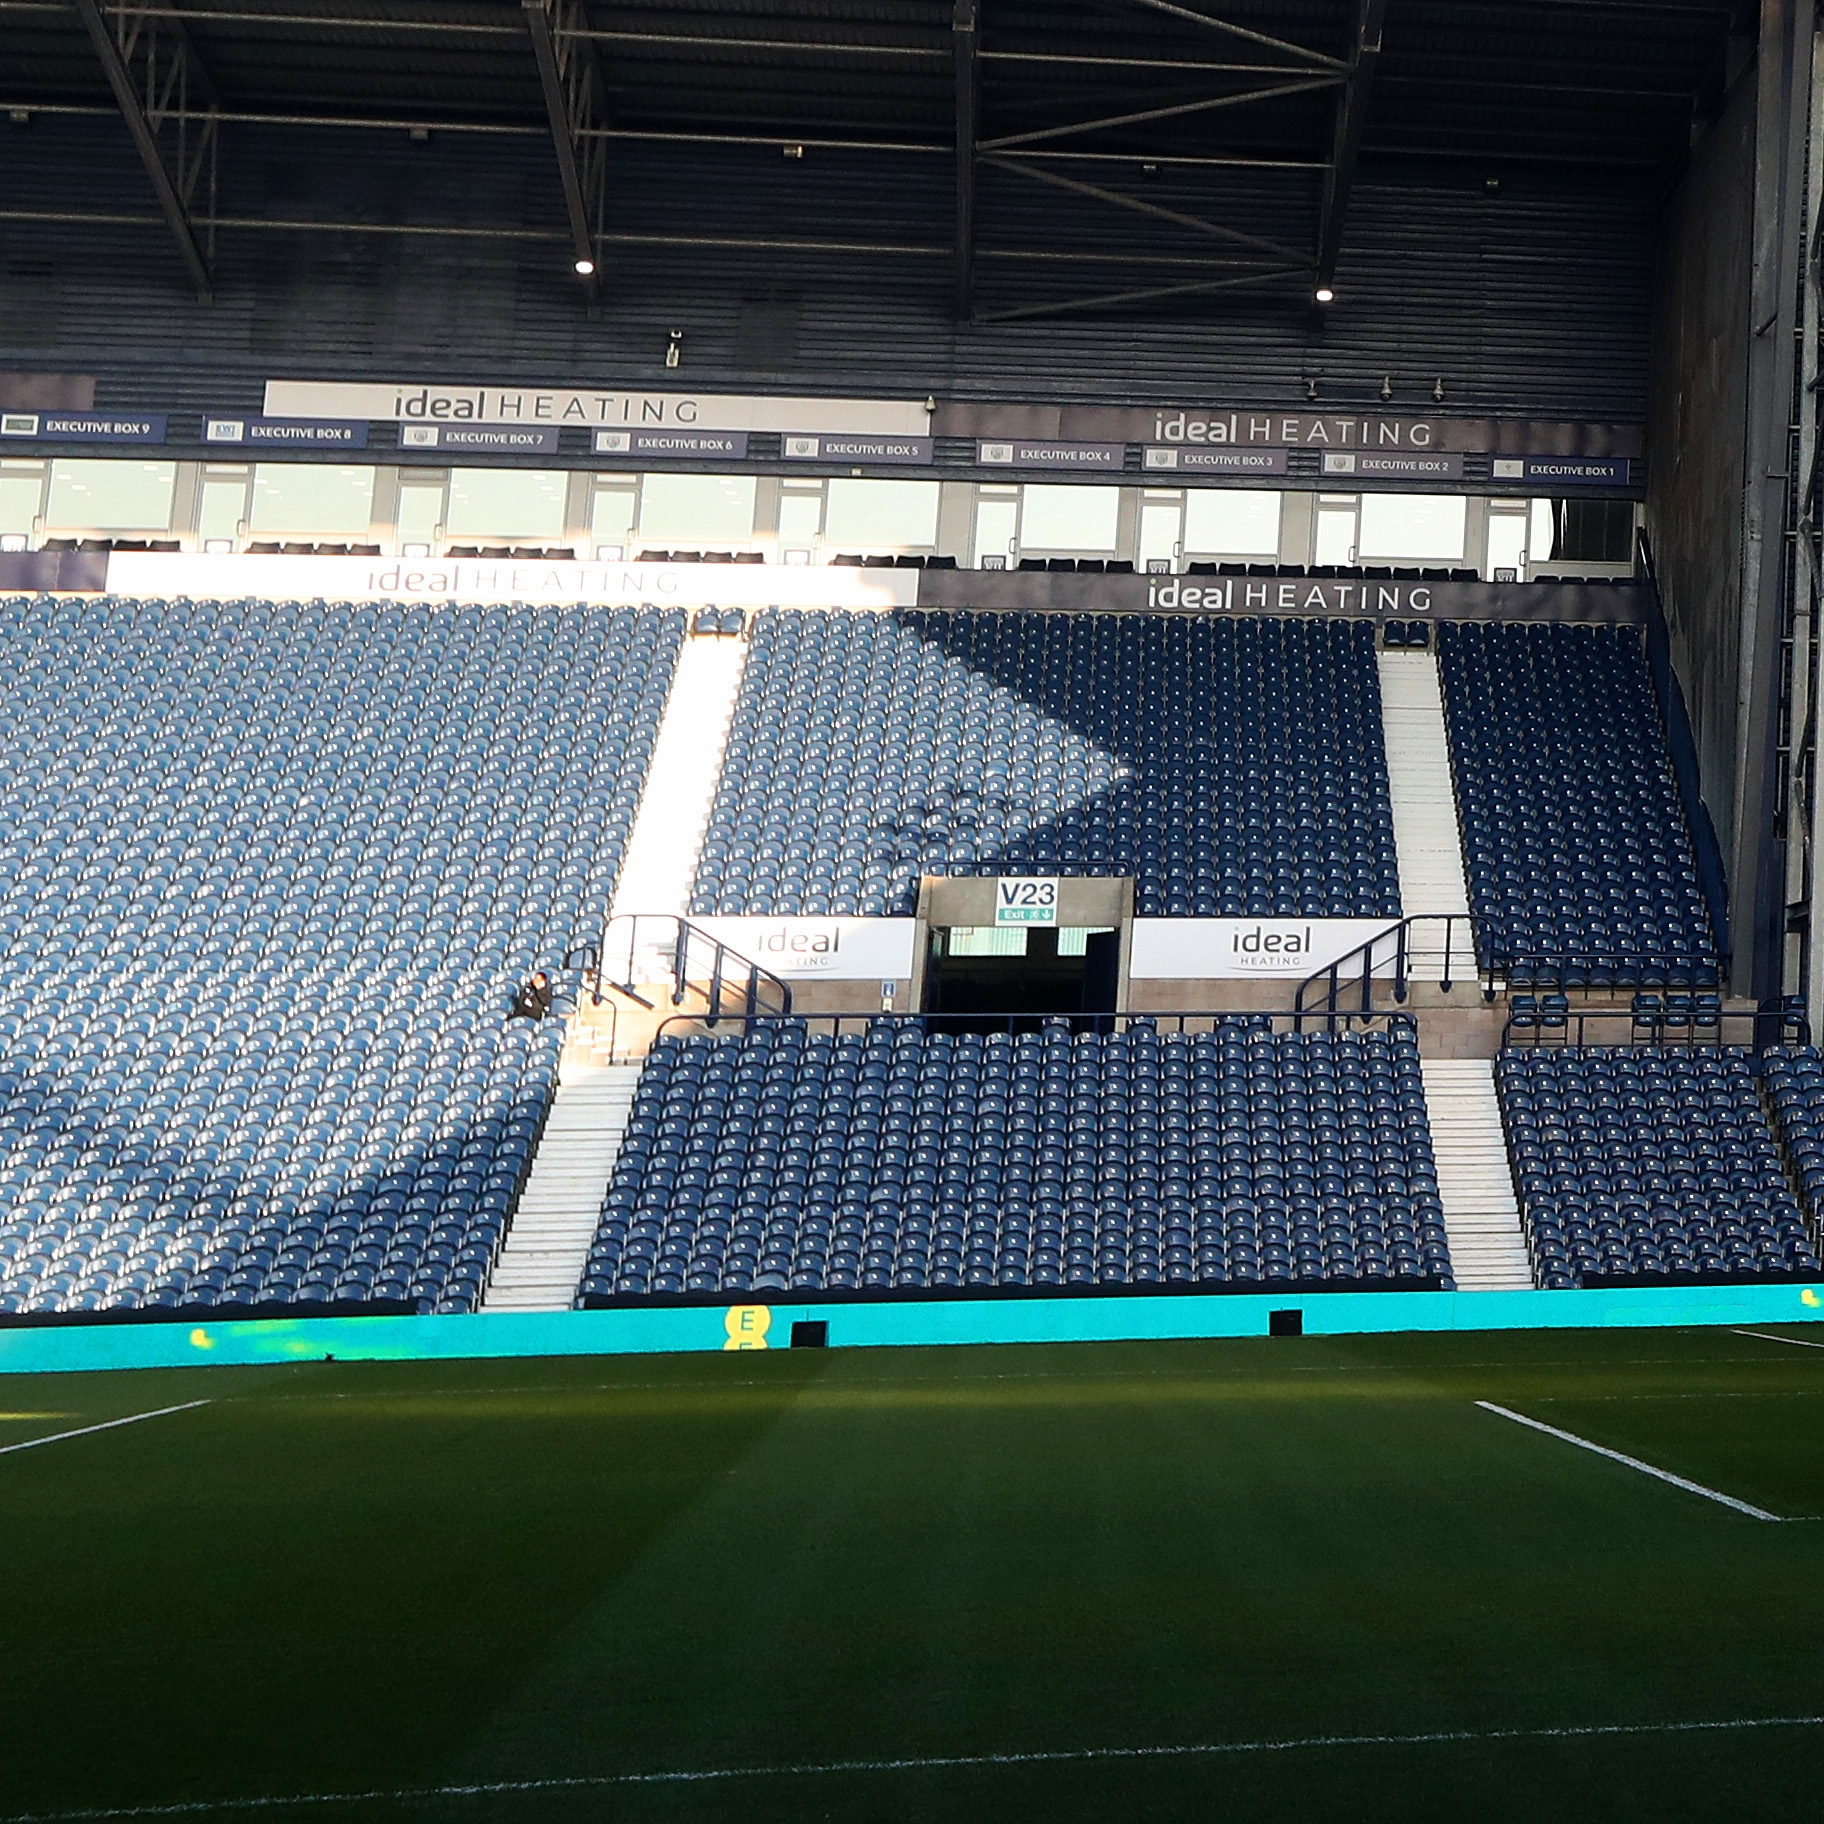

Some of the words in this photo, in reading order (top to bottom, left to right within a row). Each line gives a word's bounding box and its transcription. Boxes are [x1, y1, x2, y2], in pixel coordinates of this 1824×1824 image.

[394, 388, 485, 419] ideal
[499, 395, 699, 423] HEATING
[46, 420, 112, 433] EXECUTIVE
[114, 422, 140, 434] BOX
[142, 423, 150, 435] 9
[251, 426, 315, 439] EXECUTIVE
[317, 427, 342, 440] BOX
[1154, 412, 1237, 443] ideal
[1249, 417, 1431, 445] HEATING
[446, 432, 508, 444] EXECUTIVE
[510, 434, 534, 445] BOX
[536, 435, 544, 445] 7
[638, 438, 697, 449] EXECUTIVE
[699, 439, 724, 450] BOX
[725, 440, 733, 450] 6
[826, 443, 885, 455] EXECUTIVE
[886, 445, 910, 455] BOX
[911, 446, 919, 456] 5
[1020, 449, 1077, 460] EXECUTIVE
[1079, 451, 1102, 461] BOX
[1103, 451, 1111, 461] 4
[1184, 454, 1240, 466] EXECUTIVE
[1242, 456, 1265, 466] BOX
[1266, 457, 1273, 466] 3
[1362, 459, 1417, 470] EXECUTIVE
[1418, 461, 1441, 471] BOX
[1441, 462, 1449, 471] 2
[1530, 465, 1584, 475] EXECUTIVE
[1585, 466, 1607, 476] BOX
[1609, 467, 1615, 476] 1
[368, 564, 460, 592] ideal
[476, 569, 679, 594] HEATING
[1148, 578, 1232, 610] ideal
[1246, 584, 1432, 611] HEATING
[1000, 882, 1055, 906] V23
[1004, 909, 1025, 920] Exit
[758, 926, 839, 953] ideal
[1232, 925, 1311, 953] ideal
[1240, 956, 1301, 966] HEATING
